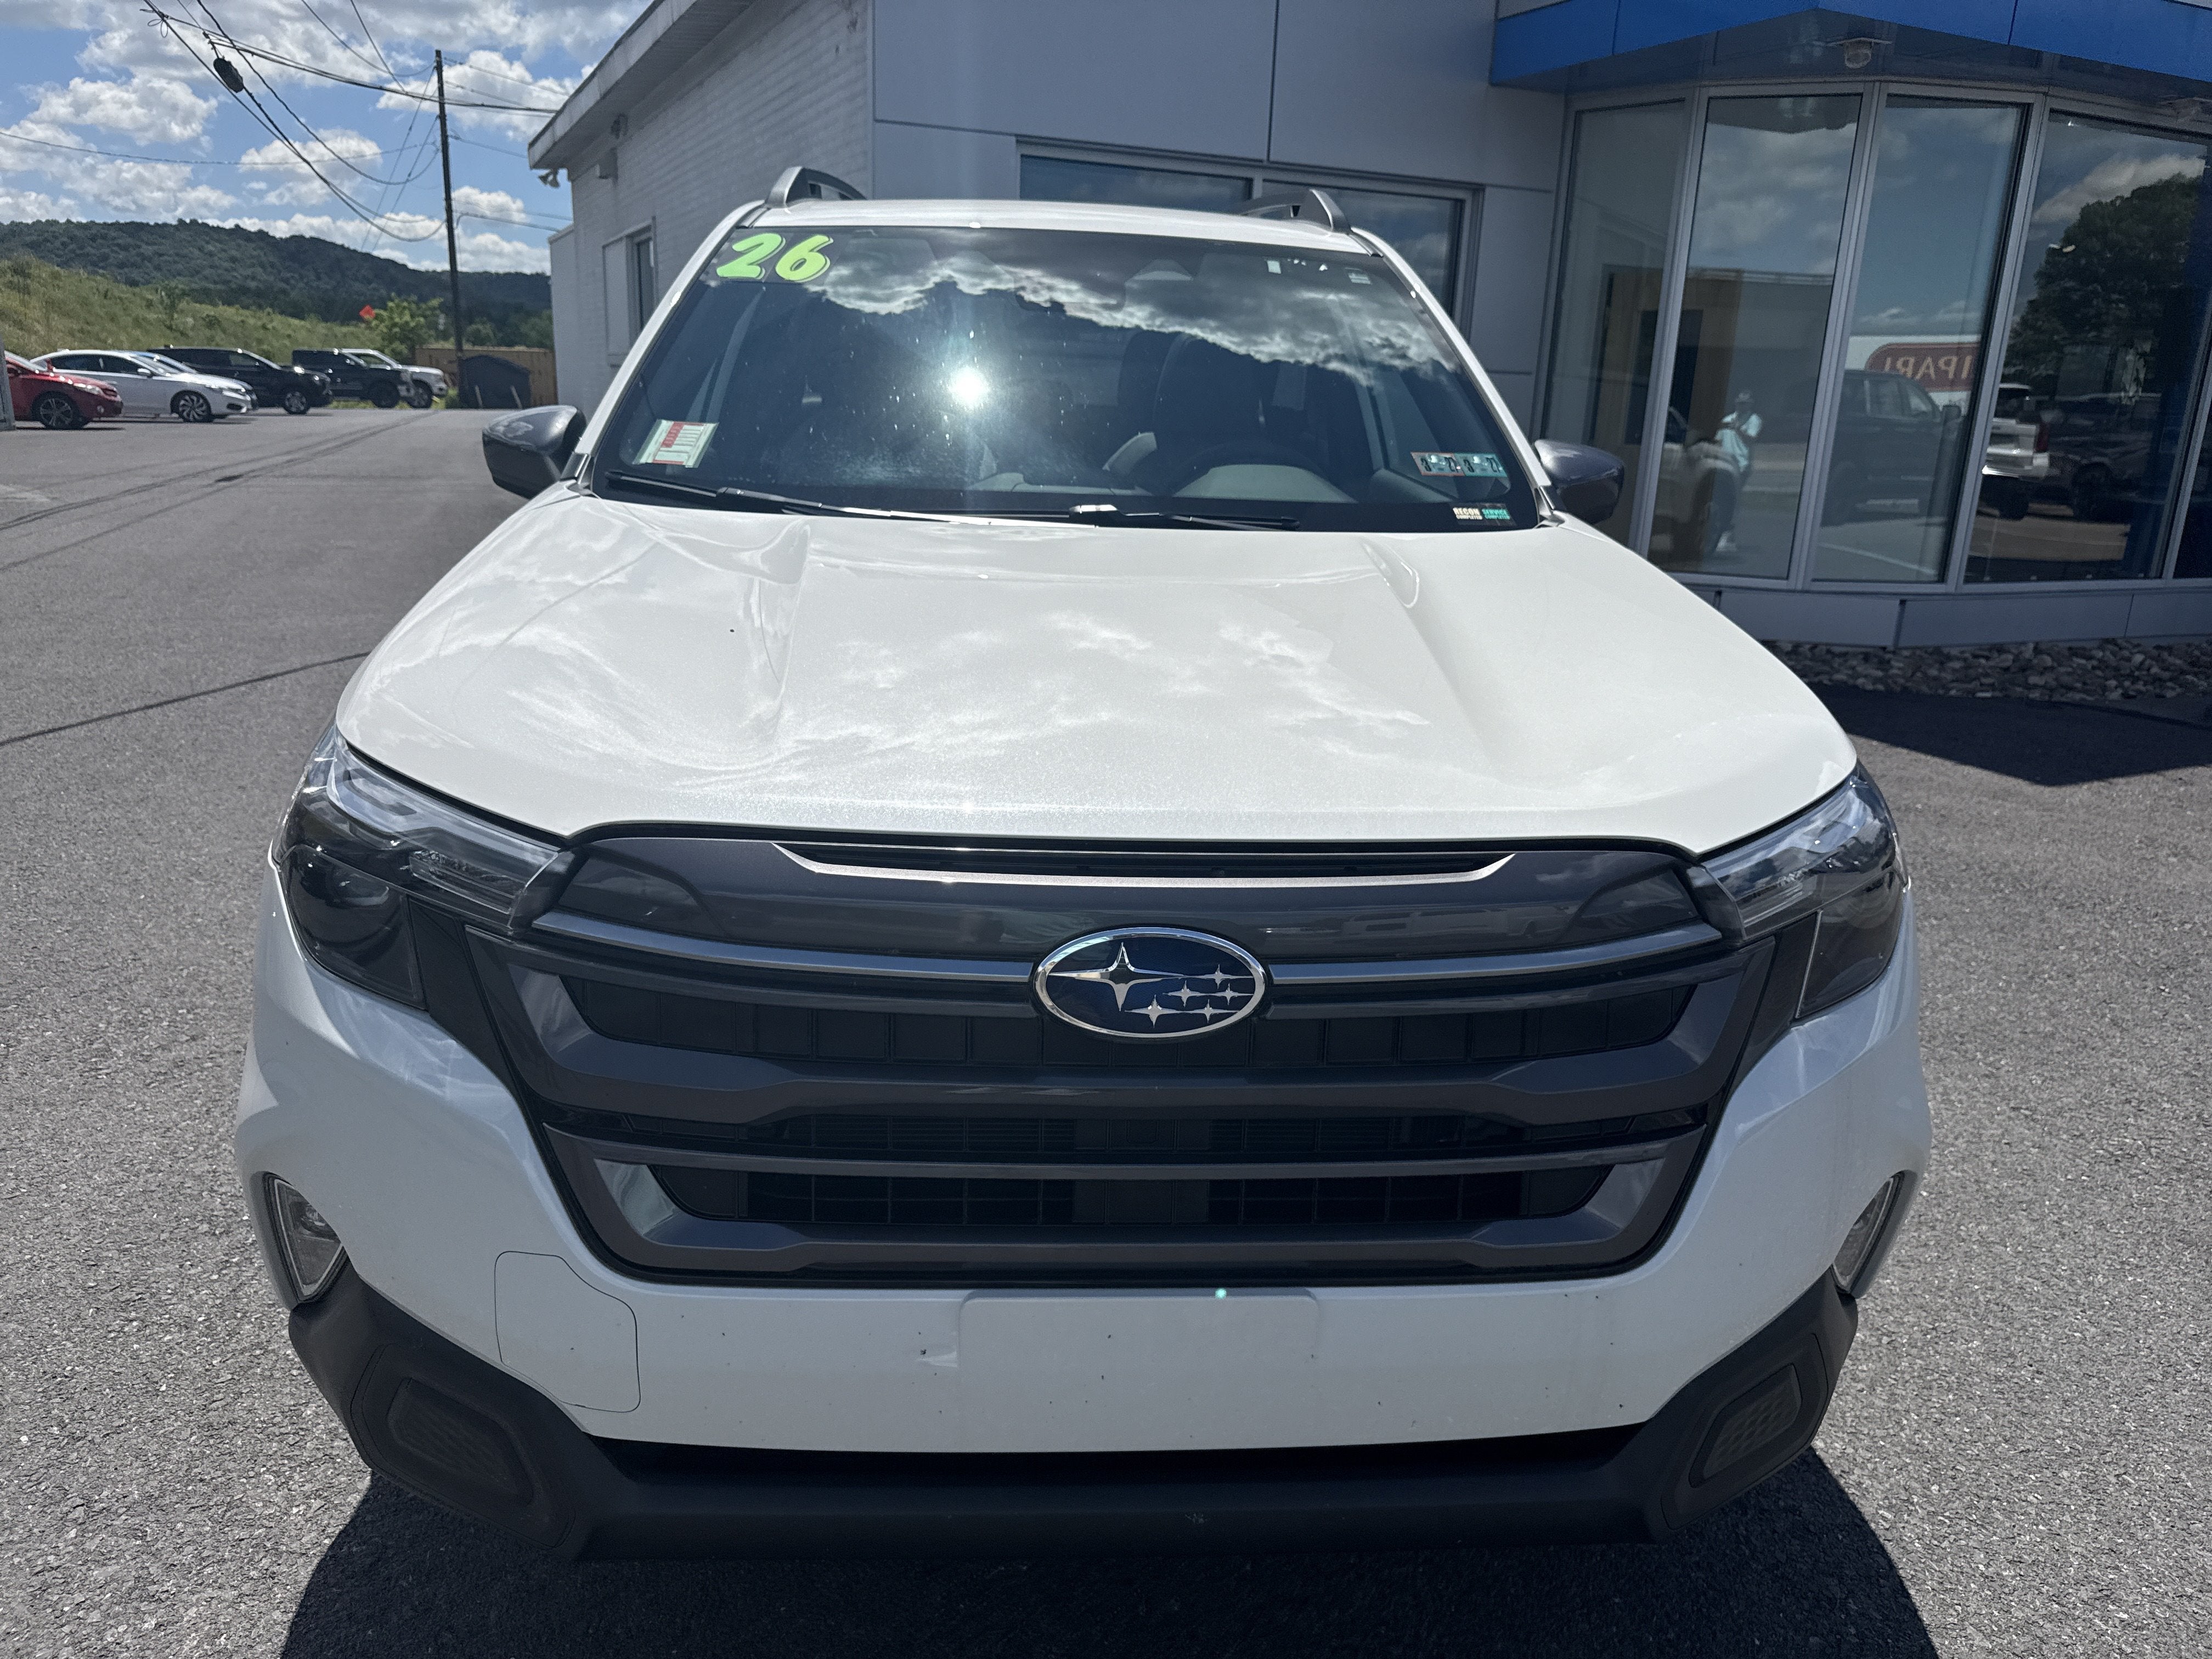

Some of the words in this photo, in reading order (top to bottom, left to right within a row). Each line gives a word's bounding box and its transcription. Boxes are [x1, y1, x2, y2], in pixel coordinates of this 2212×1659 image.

[716, 233, 834, 283] 26
[1420, 457, 1432, 472] 3
[1463, 459, 1475, 473] 3
[1453, 507, 1481, 516] RECON
